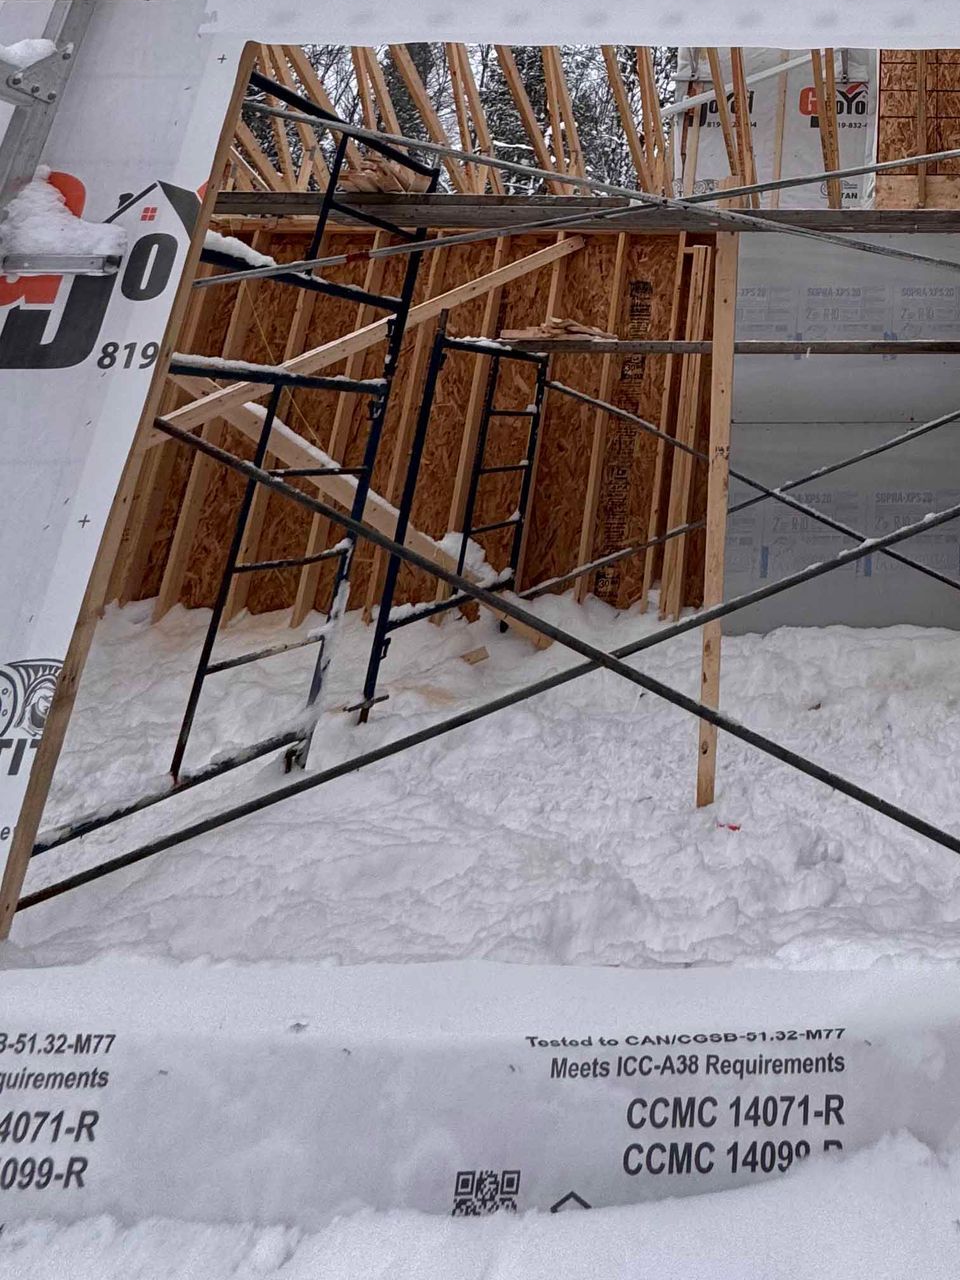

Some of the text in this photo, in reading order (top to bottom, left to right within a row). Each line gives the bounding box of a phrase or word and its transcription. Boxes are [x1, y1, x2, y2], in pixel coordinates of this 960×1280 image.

[525, 1027, 847, 1049] Tested to CAN/CGSB-51.32-M77
[550, 1051, 846, 1080] Meets ICC-A38 Requirements
[626, 1093, 846, 1130] CCMC 14071-R
[622, 1140, 716, 1176] CCMC
